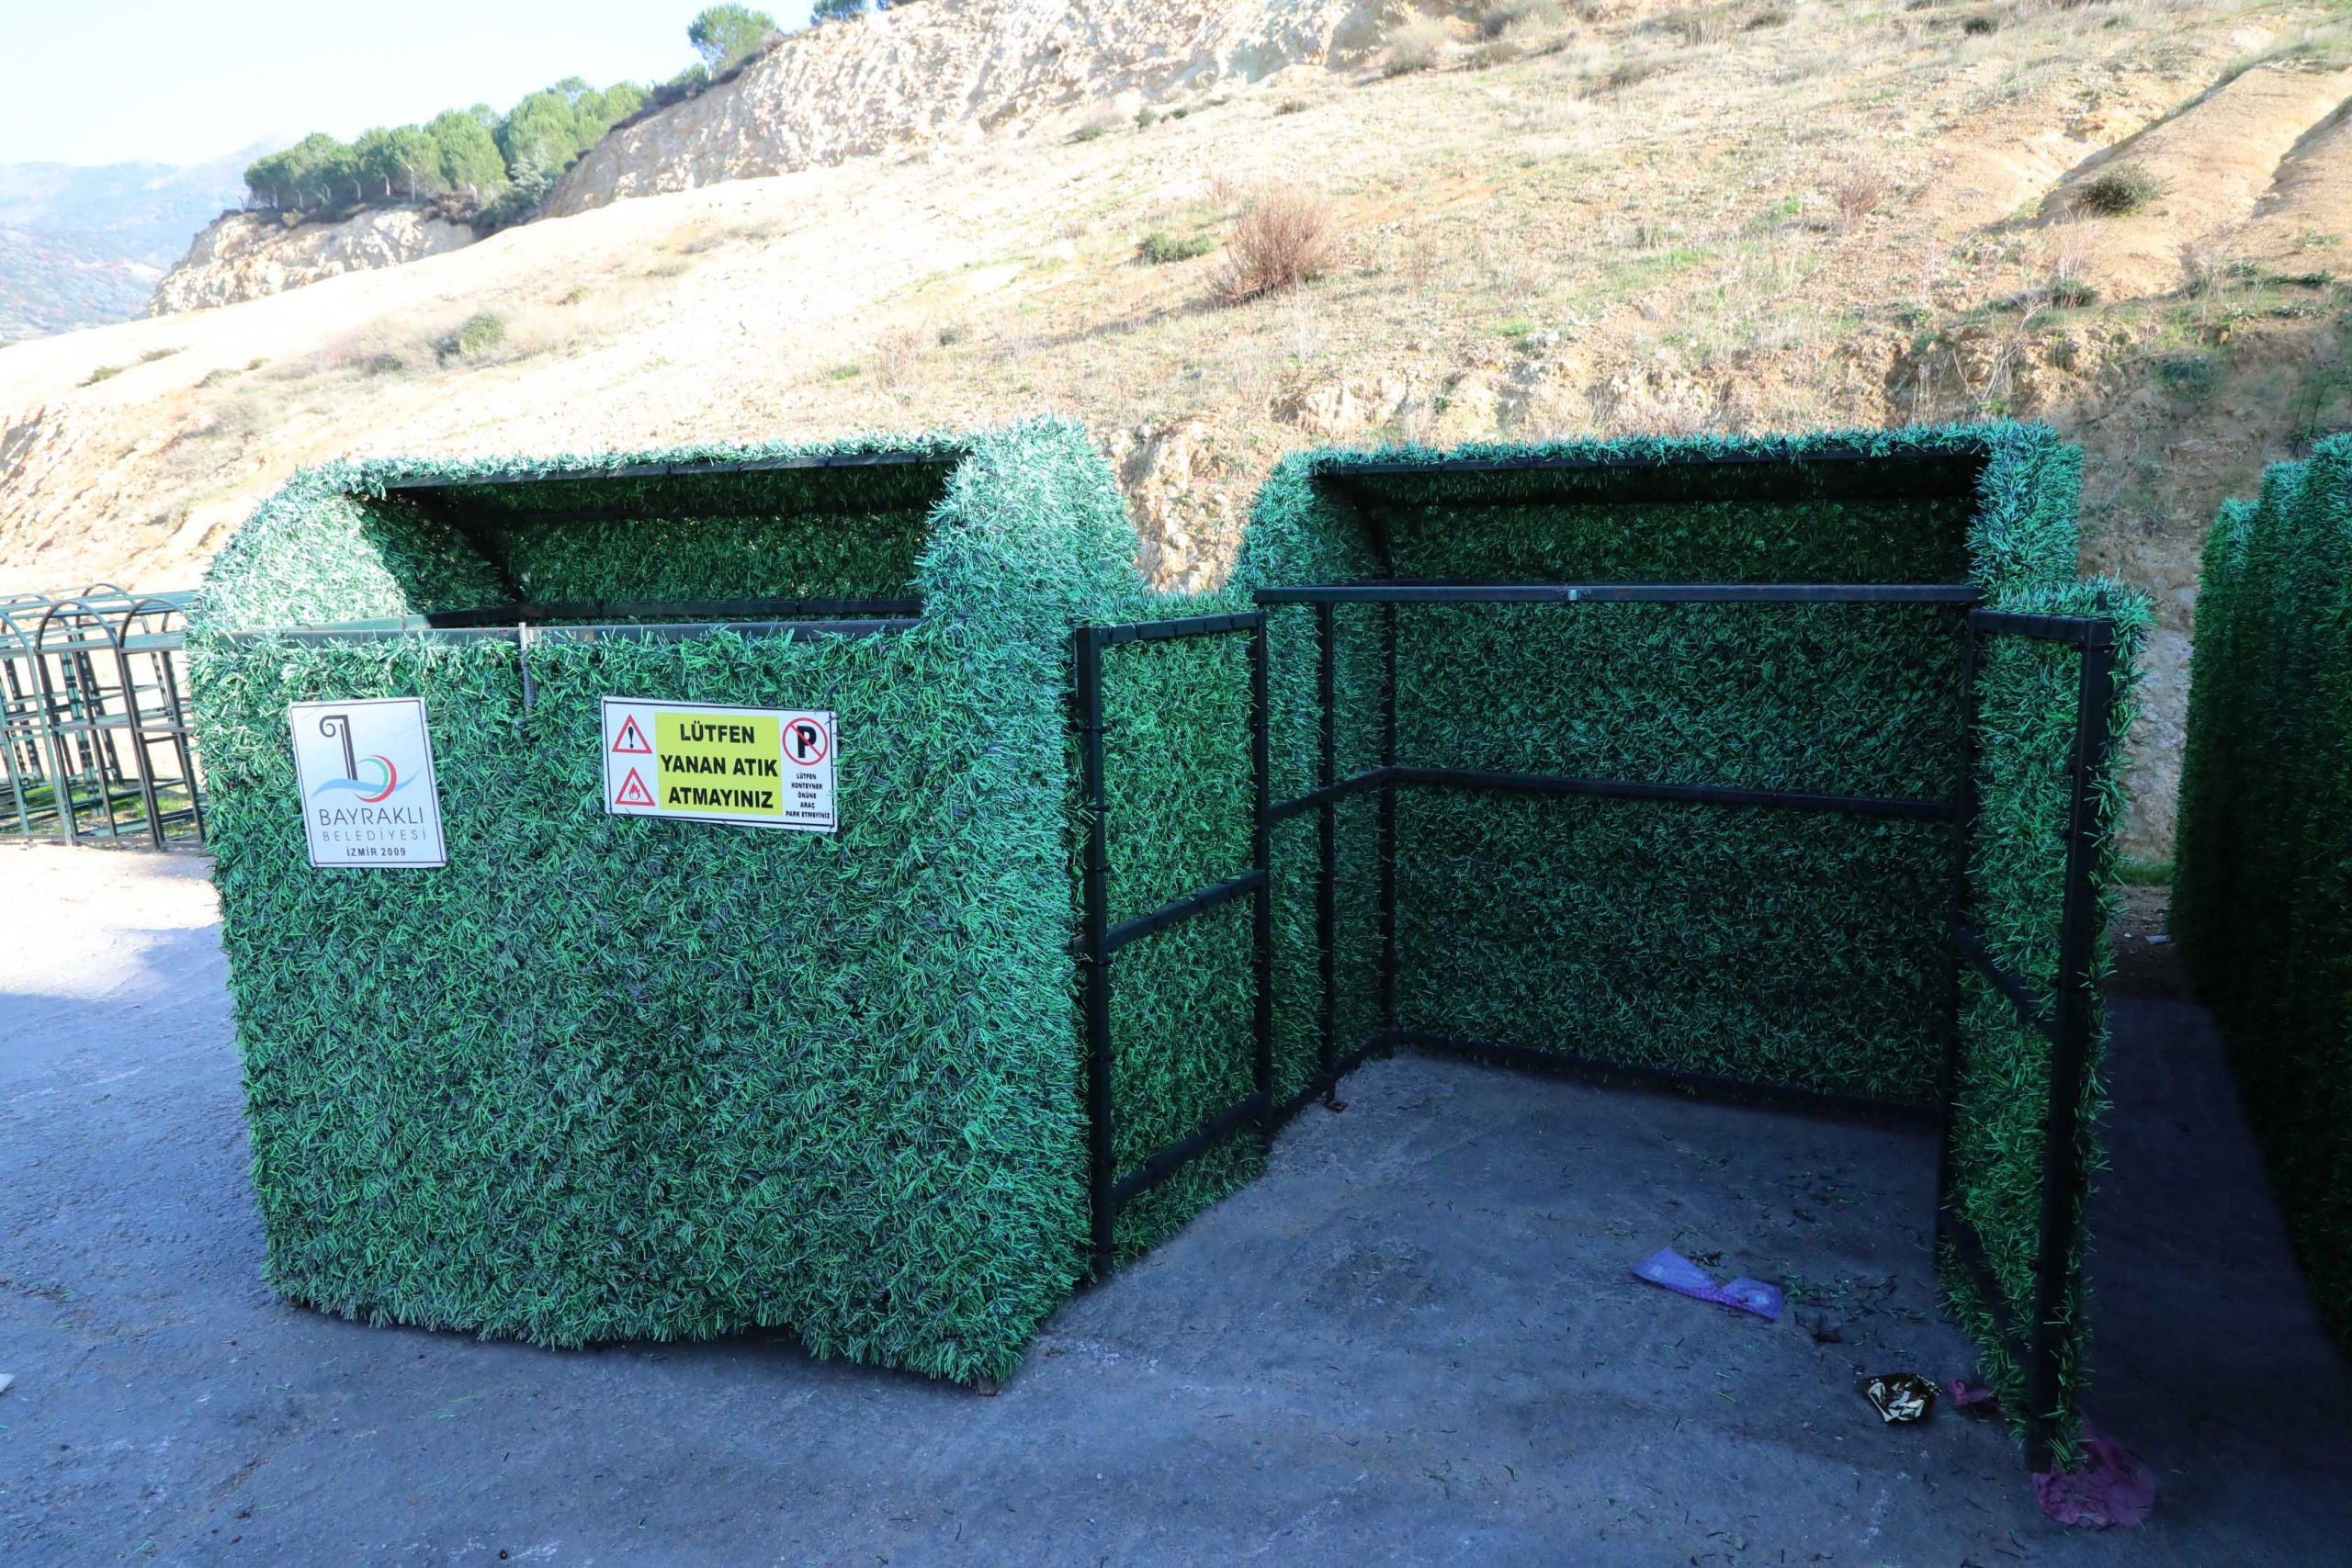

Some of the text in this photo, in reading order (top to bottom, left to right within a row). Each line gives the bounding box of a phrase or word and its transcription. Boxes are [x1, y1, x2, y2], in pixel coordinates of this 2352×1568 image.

[680, 720, 755, 744] LÜTFEN
[660, 754, 778, 777] YANAN ATIK
[797, 772, 817, 780] LÜTFEN
[791, 782, 823, 790] KONTEYNER
[668, 786, 774, 808] ATMAYINIZ
[797, 790, 817, 799] ÖNÜNE
[799, 801, 815, 809] ARAÇ
[319, 807, 424, 826] BAYRAKLI
[322, 827, 426, 841] BELEDİYESİ
[346, 845, 406, 856] İZMİR 2009
